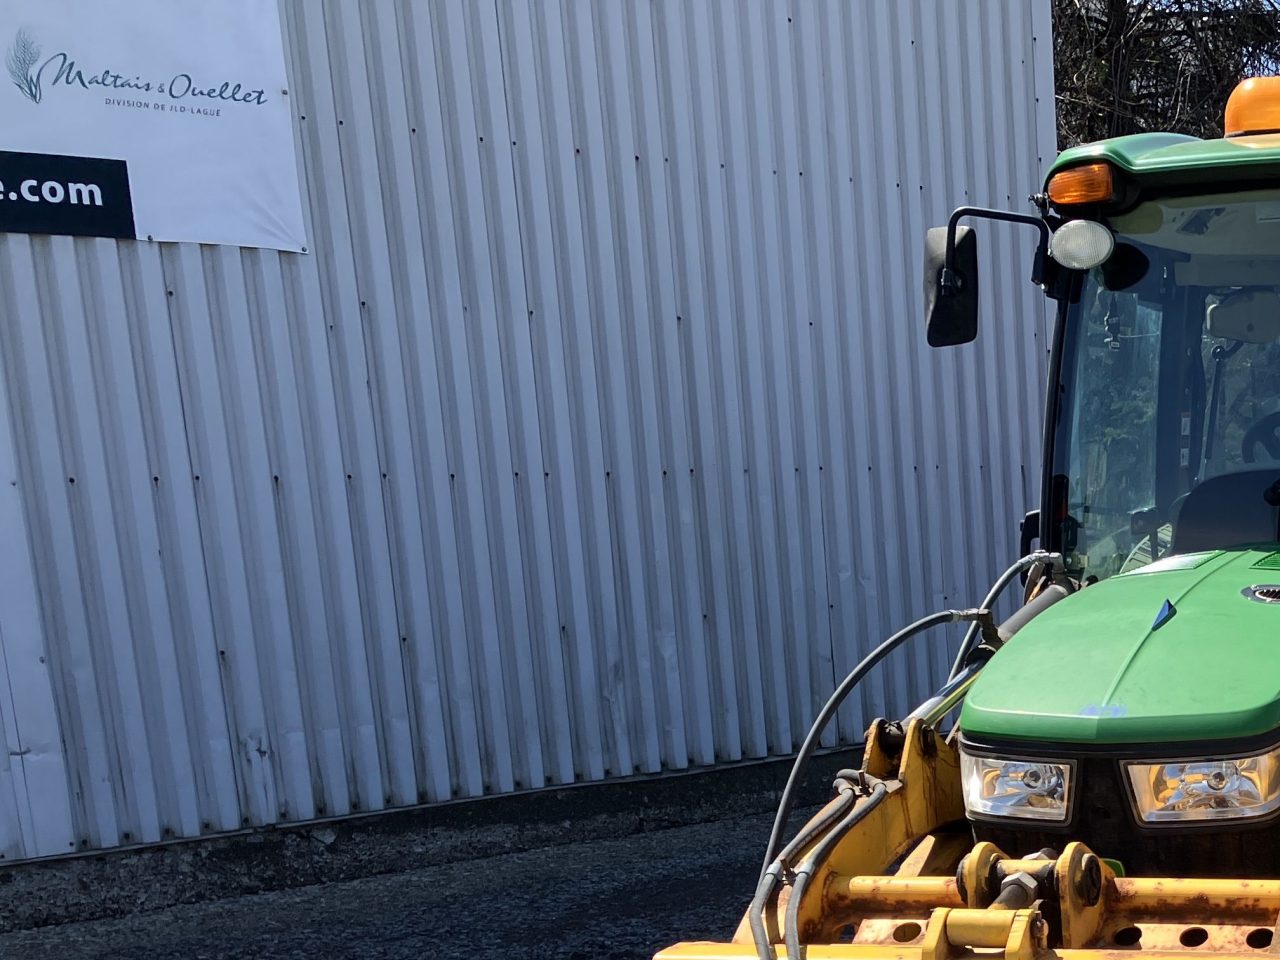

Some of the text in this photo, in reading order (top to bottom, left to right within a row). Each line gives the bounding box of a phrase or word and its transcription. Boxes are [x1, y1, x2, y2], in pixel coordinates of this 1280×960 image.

[37, 53, 268, 105] Maltais & Ouellet
[105, 98, 149, 109] DIVISION
[153, 103, 165, 111] DE
[0, 179, 103, 206] .com
